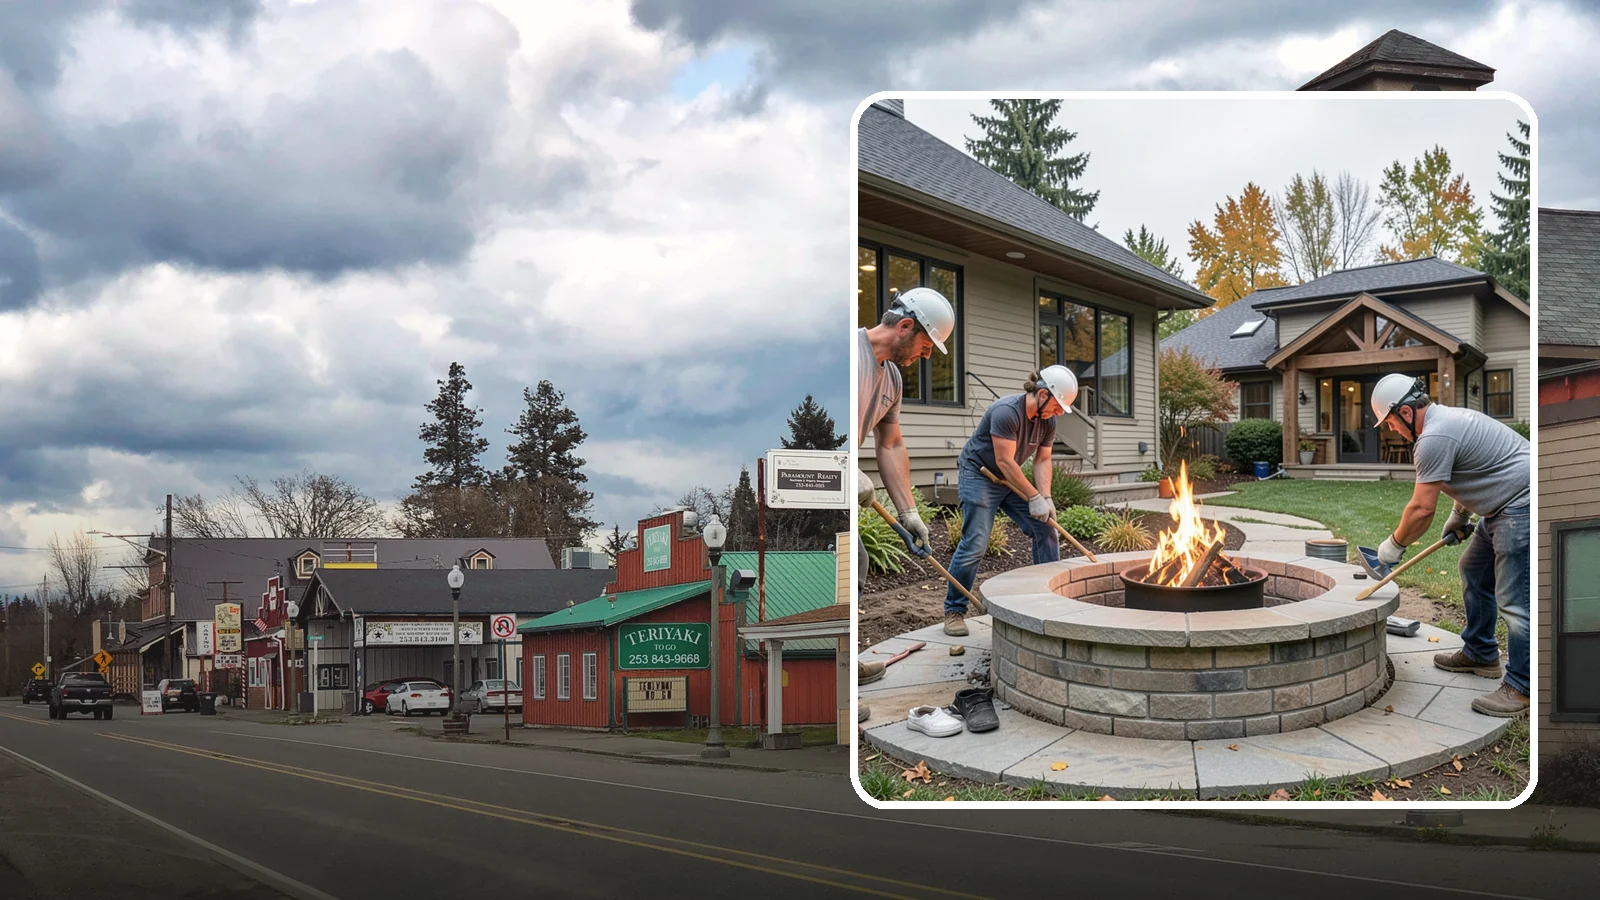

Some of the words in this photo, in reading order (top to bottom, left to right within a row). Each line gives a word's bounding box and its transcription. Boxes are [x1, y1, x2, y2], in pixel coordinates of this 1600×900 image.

[817, 473, 838, 481] REALTY
[624, 627, 702, 645] TERIYAKI
[629, 654, 648, 664] 253
[651, 653, 700, 664] 843-9668
[639, 681, 673, 691] TERIYAKI
[662, 690, 672, 700] GO
